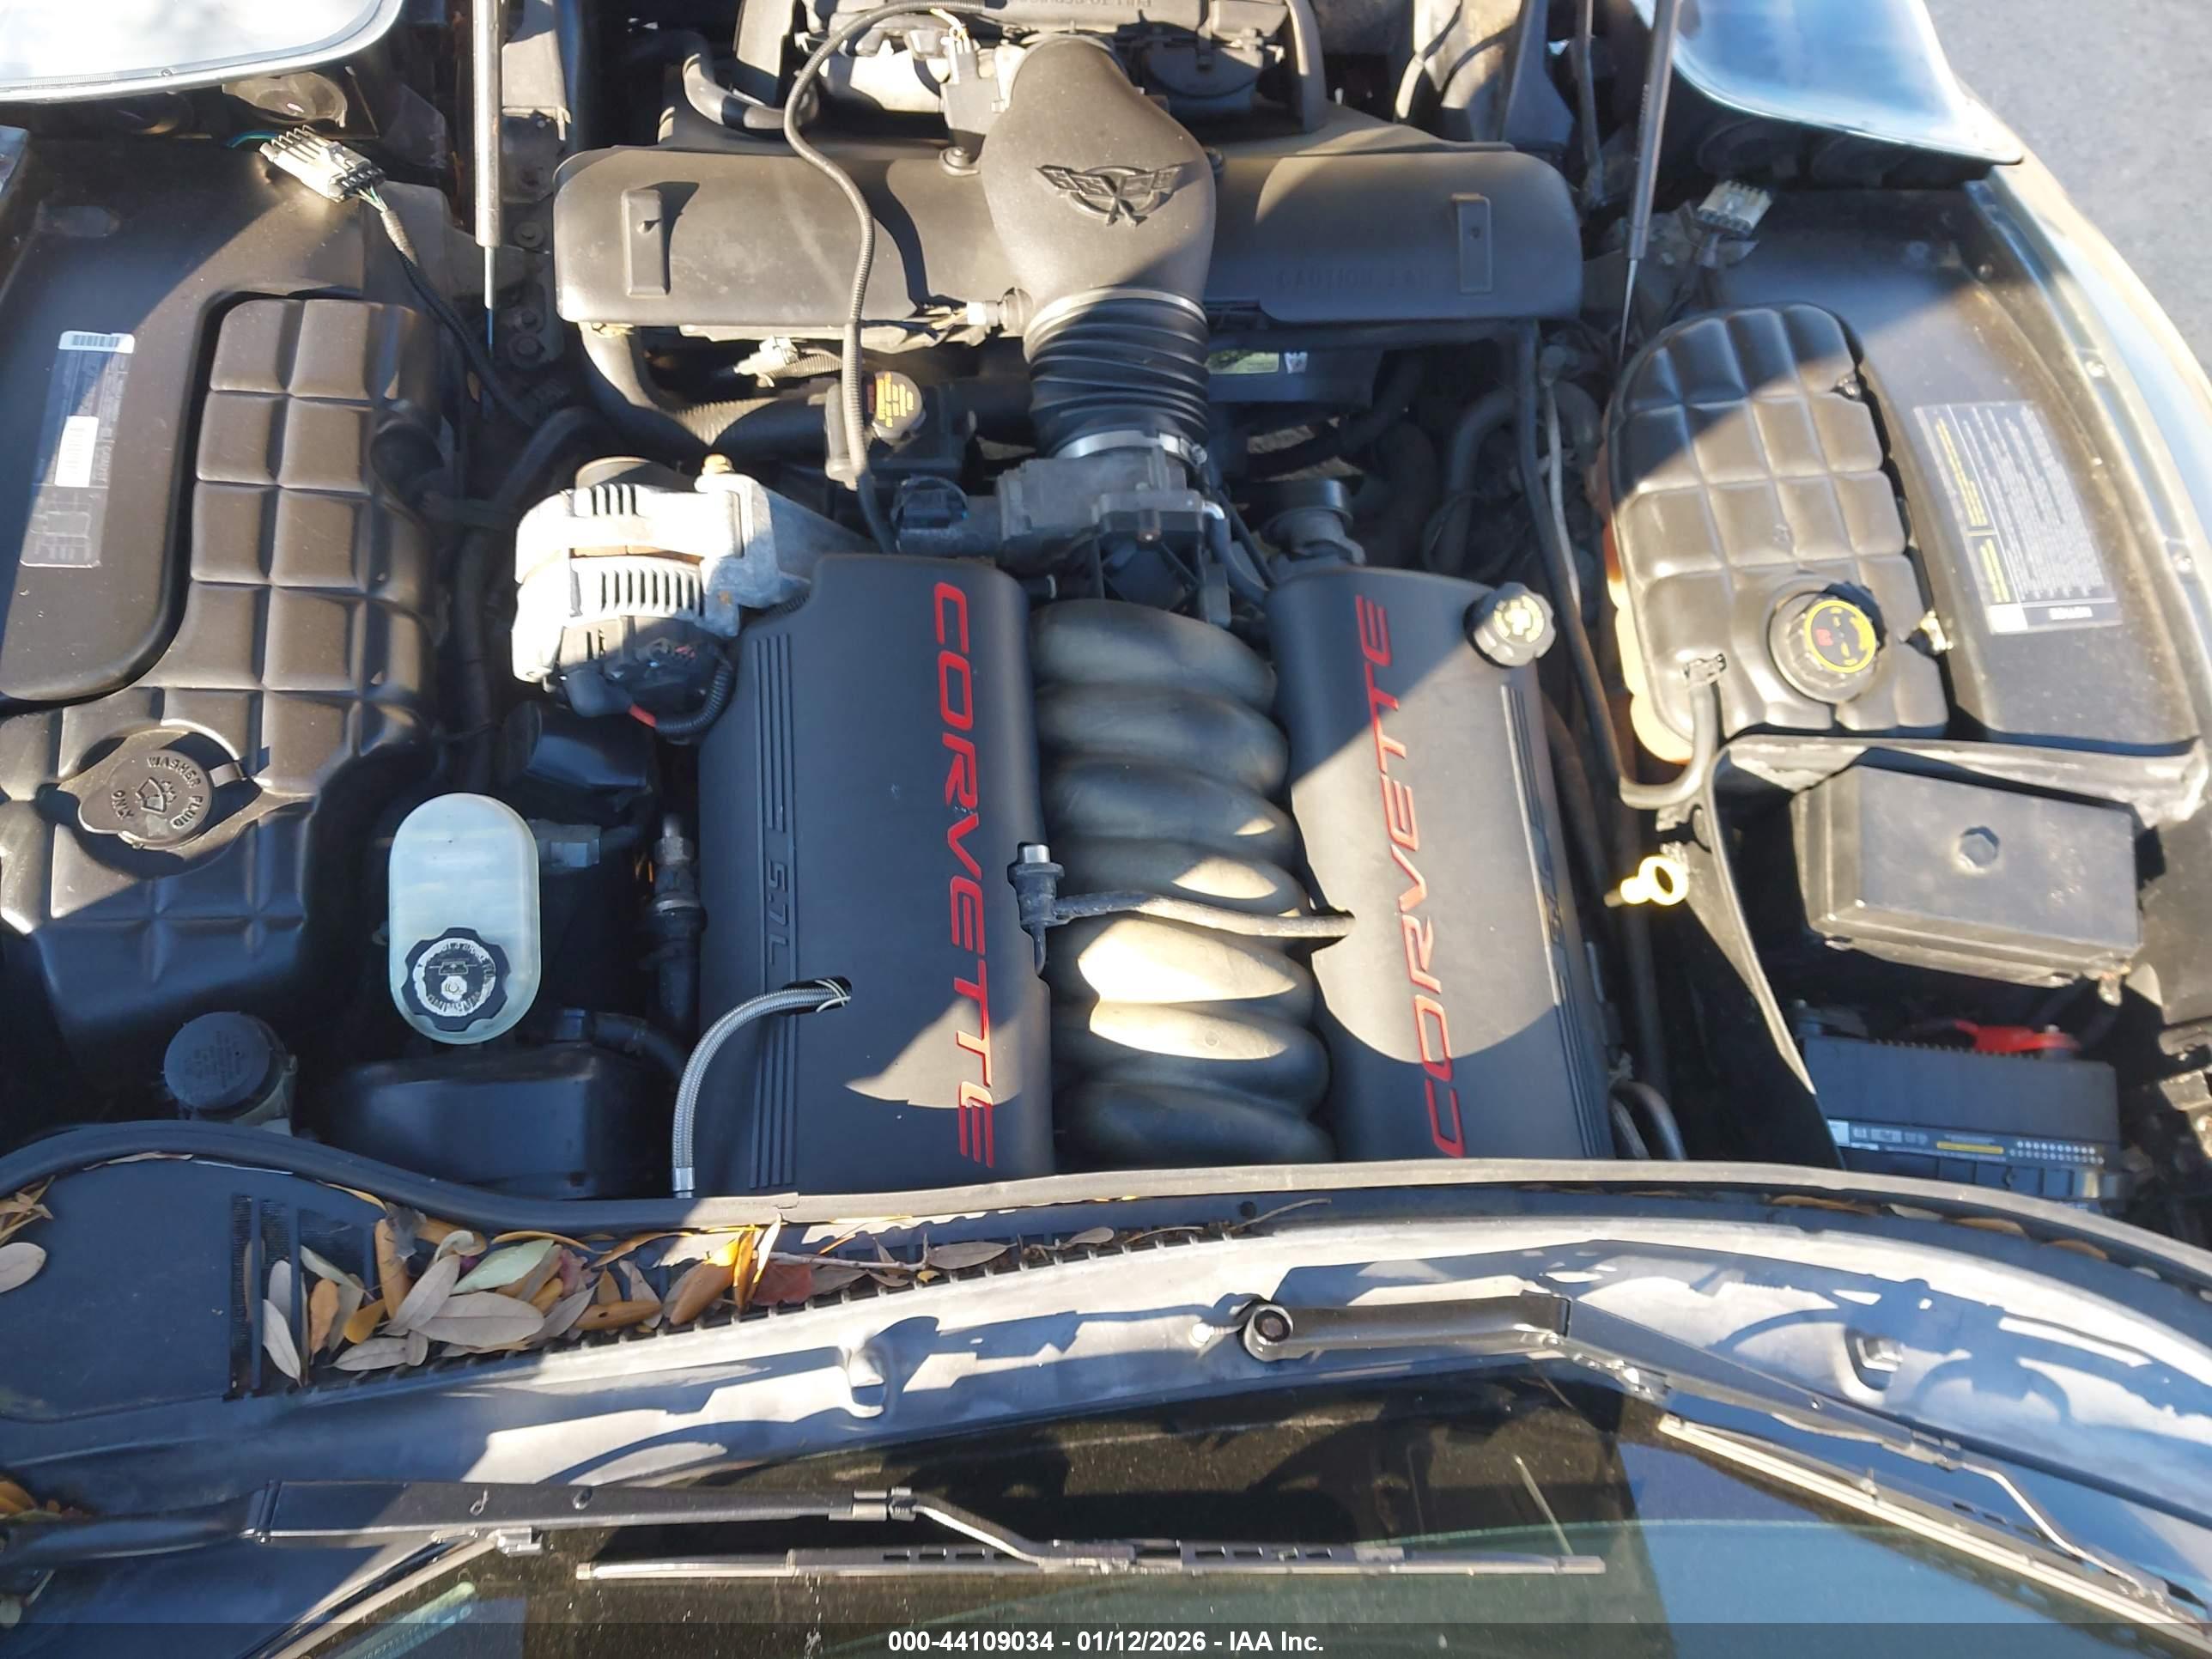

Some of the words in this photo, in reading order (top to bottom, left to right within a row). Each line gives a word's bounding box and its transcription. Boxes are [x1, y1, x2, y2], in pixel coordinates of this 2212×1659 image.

[112, 788, 136, 822] ONLY
[147, 756, 202, 789] WASHER
[170, 794, 204, 830] FLUID
[934, 581, 995, 1166] CORVETTE
[1356, 593, 1465, 1158] CORVETTE
[767, 858, 789, 966] 5.7L
